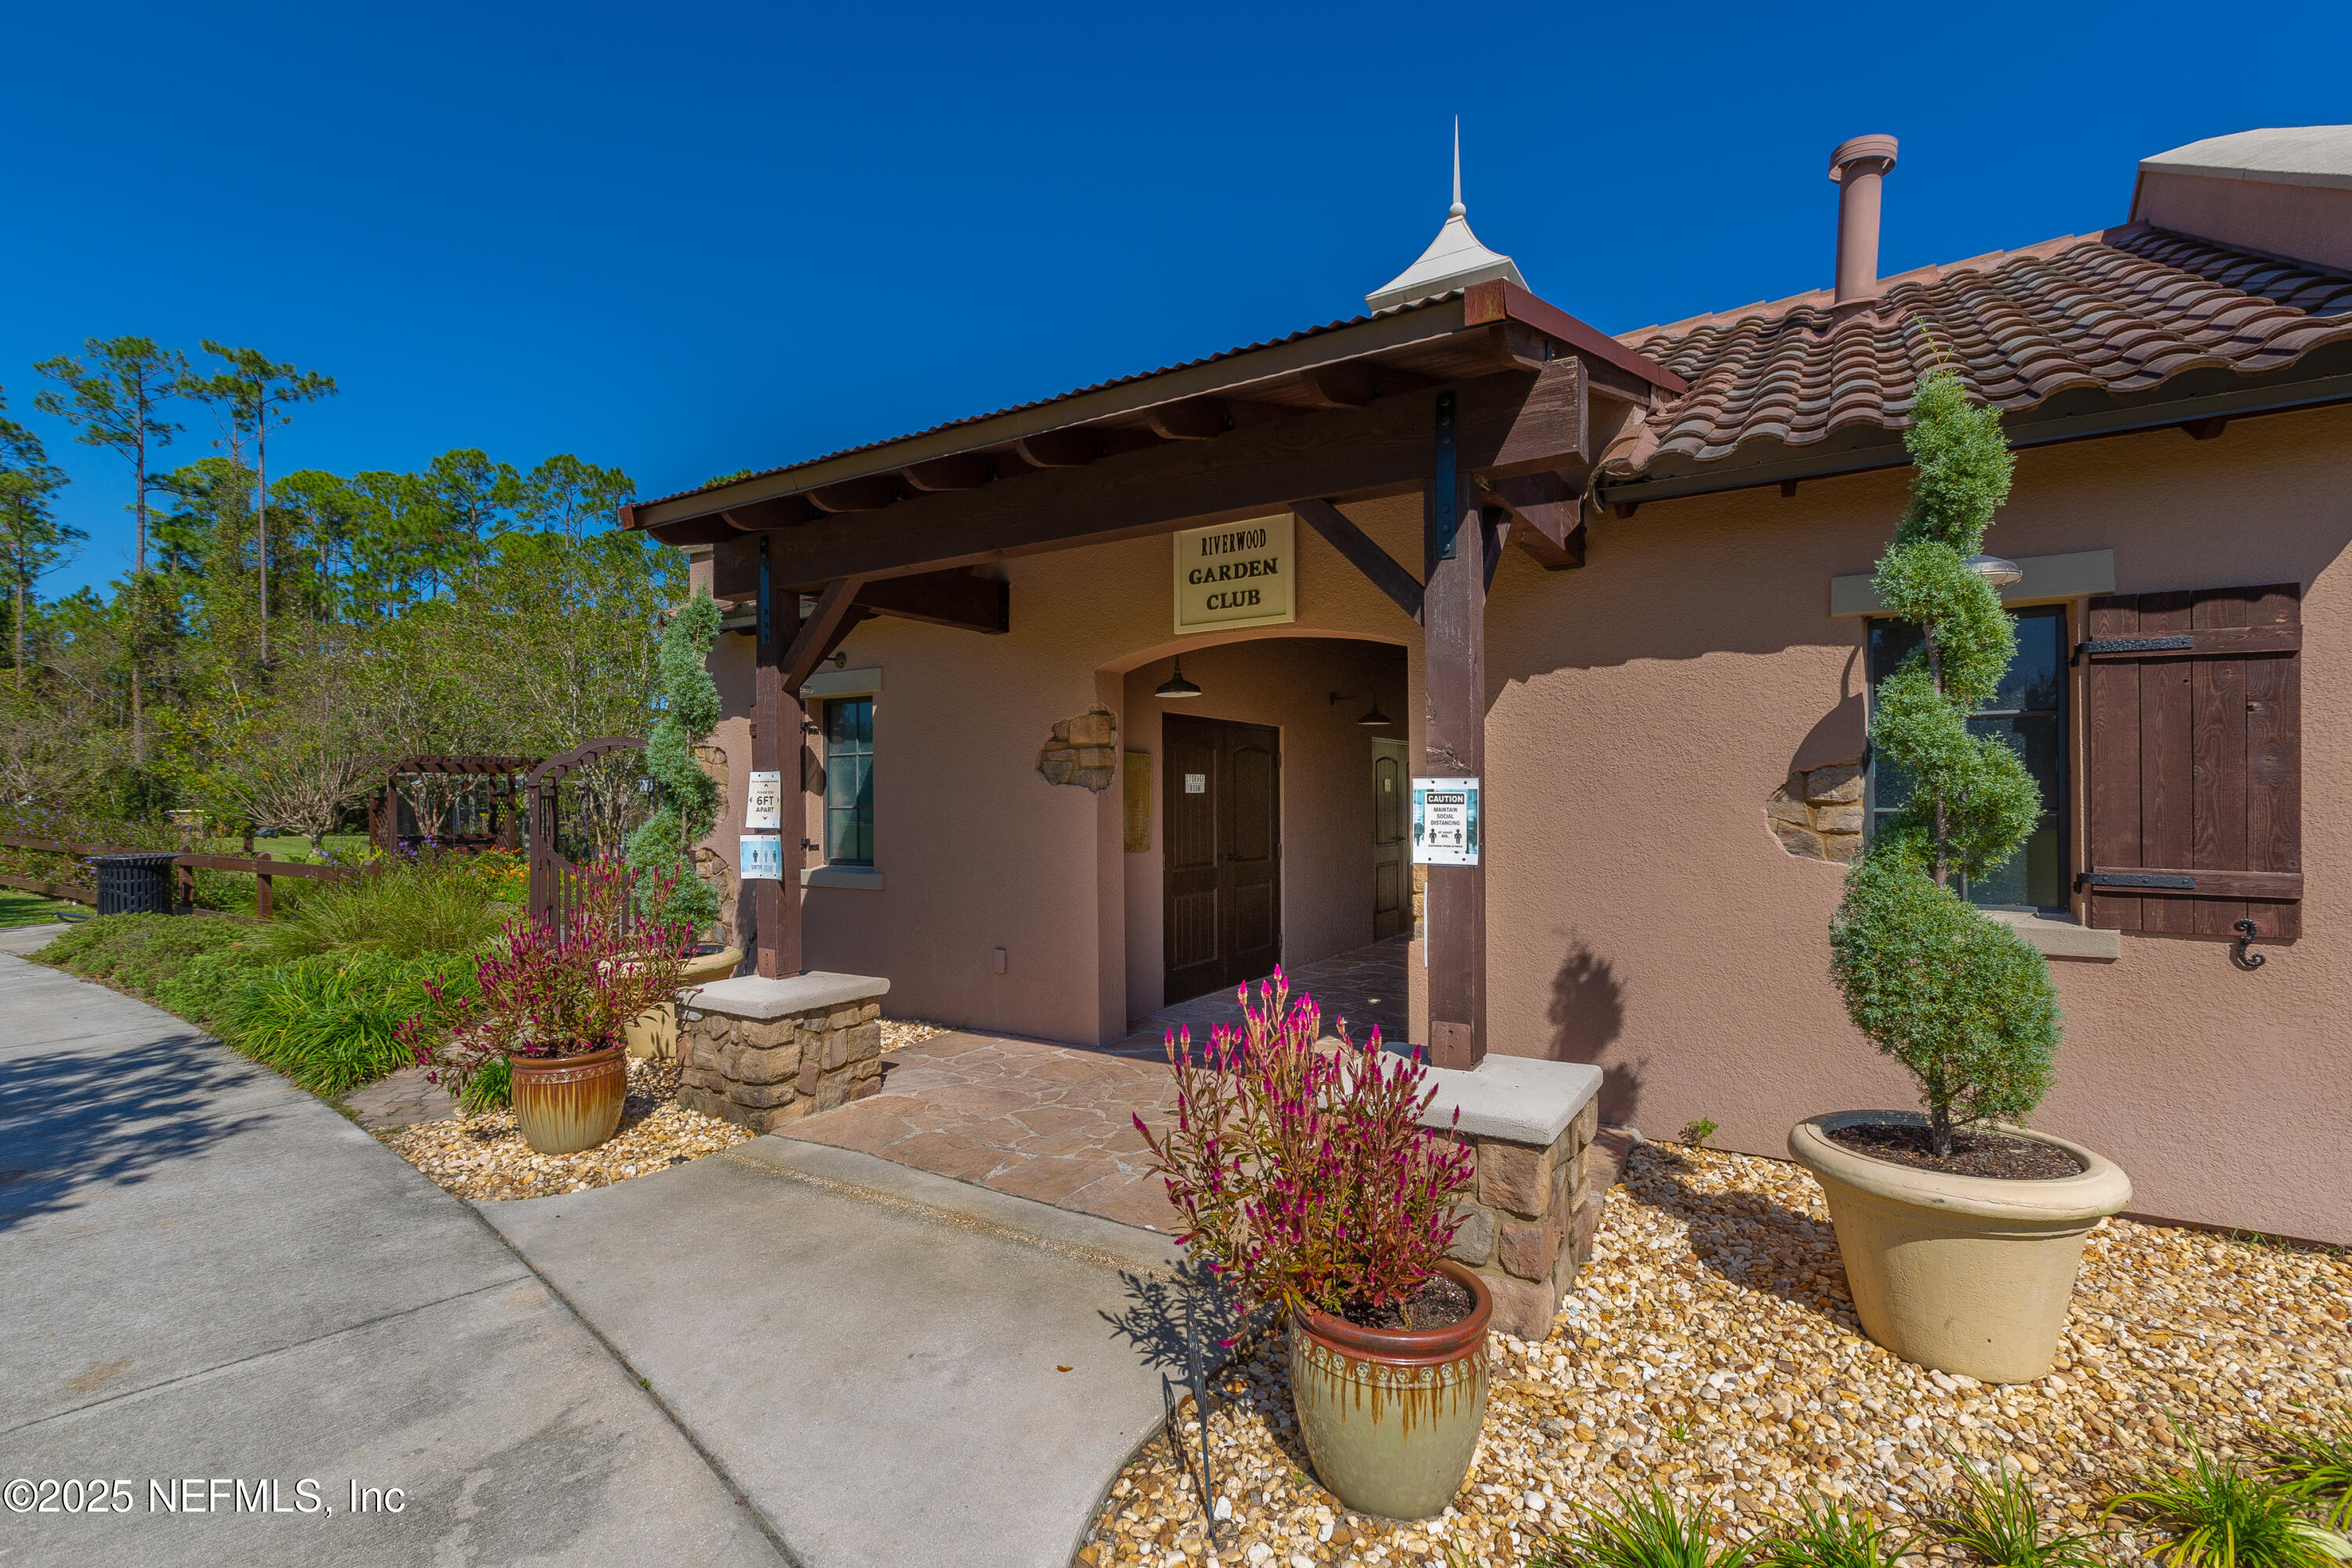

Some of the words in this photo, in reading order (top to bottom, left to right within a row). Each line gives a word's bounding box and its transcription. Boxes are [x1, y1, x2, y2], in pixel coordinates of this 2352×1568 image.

[1201, 528, 1266, 557] RIVERWOOD
[1189, 557, 1279, 585] GARDEN
[1206, 590, 1261, 610] CLUB
[1185, 775, 1204, 783] STORAGE
[757, 796, 774, 805] 6FT
